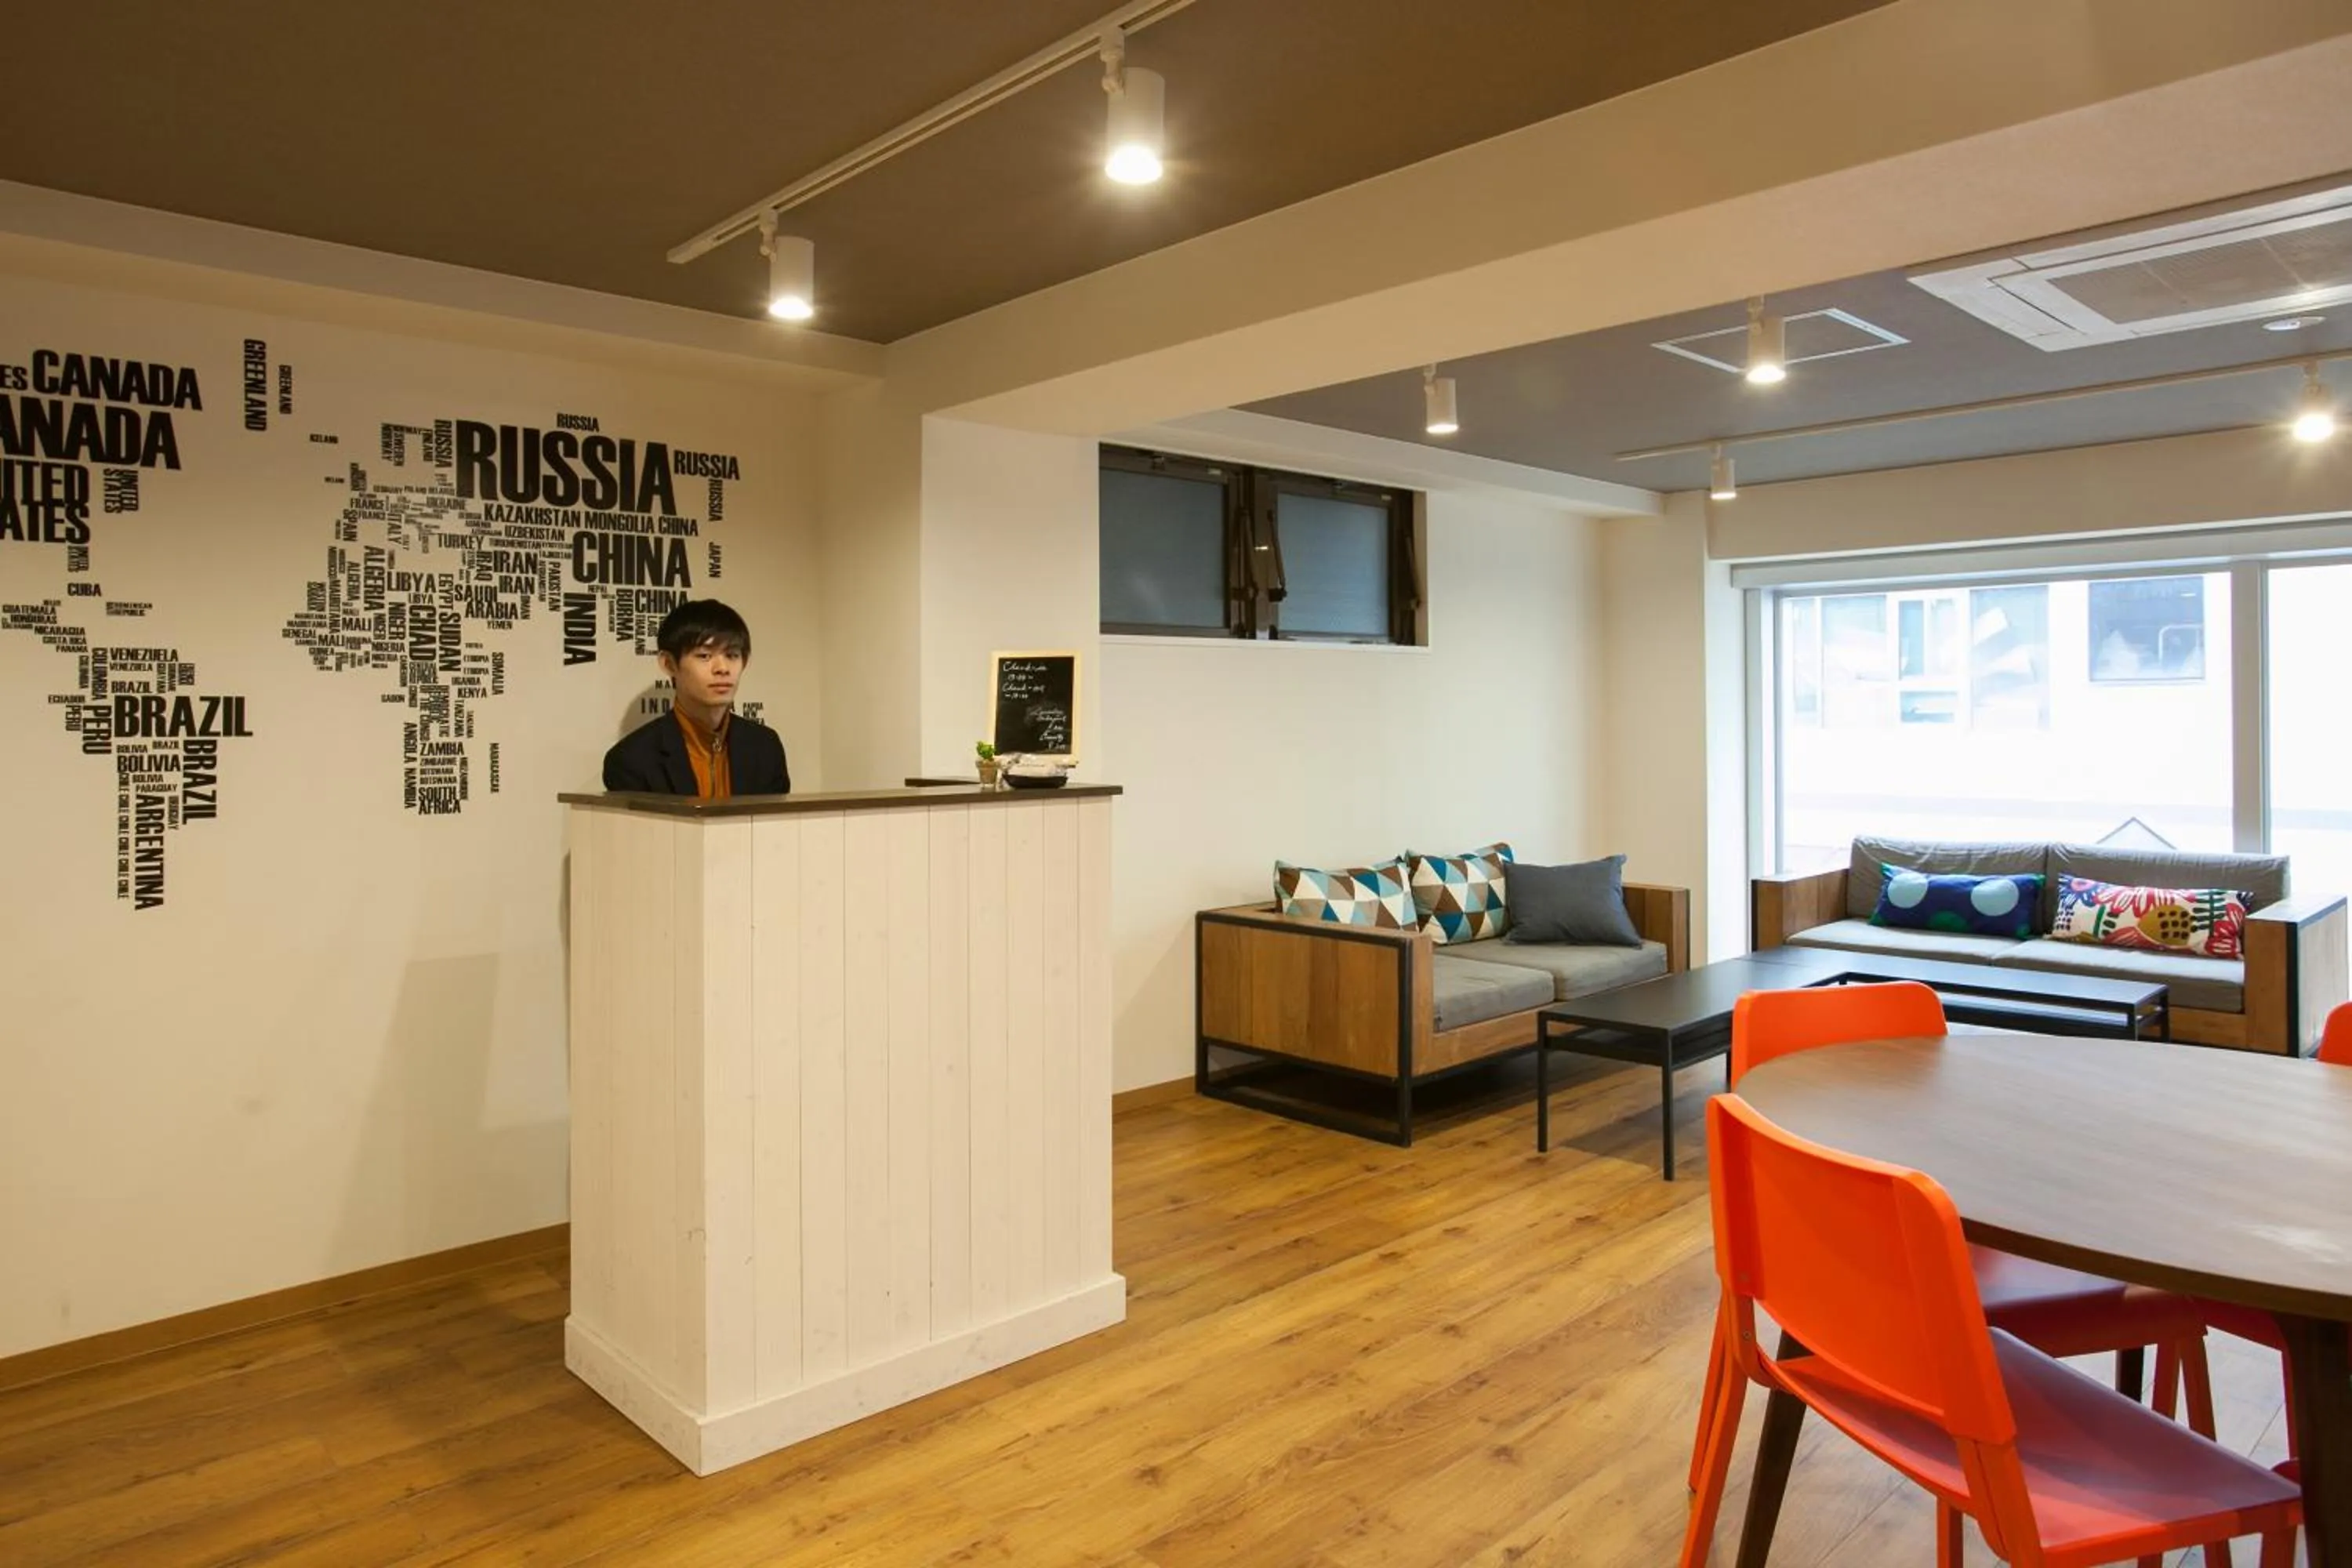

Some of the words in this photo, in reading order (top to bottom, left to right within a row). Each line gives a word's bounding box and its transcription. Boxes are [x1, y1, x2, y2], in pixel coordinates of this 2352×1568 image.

[33, 350, 202, 411] CANADA
[244, 339, 267, 431] GREENLAND
[279, 365, 292, 414] GREENLAND
[557, 413, 600, 432] RUSSIA
[435, 419, 452, 467] RUSSIA
[456, 419, 677, 516] RUSSIA
[673, 449, 740, 481] RUSSIA
[0, 459, 89, 507] ITED
[103, 469, 122, 514] STATES
[121, 470, 139, 511] UNITED
[350, 498, 384, 510] FRANCE
[709, 478, 724, 521] RUSSIA
[343, 509, 358, 542] SPAIN
[388, 513, 402, 545] ITALY
[484, 503, 581, 528] KAZAKHSTAN
[585, 510, 655, 535] MONGOLIA
[659, 514, 699, 536] CHINA
[504, 524, 565, 541] UZBEKISTAN
[437, 533, 485, 550] TURKEY
[474, 550, 492, 581] IRAQ
[493, 550, 537, 574] IRAN
[572, 530, 691, 588] CHINA
[709, 542, 721, 578] JAPAN
[67, 583, 101, 597] CUBA
[347, 561, 360, 601] ALGERIA
[364, 545, 385, 612] ALGERIA
[387, 571, 436, 593] LIBYA
[438, 573, 454, 610] EGYPT
[455, 584, 498, 602] SAUDI
[499, 575, 535, 594] IRAN
[549, 561, 561, 612] PAKISTAN
[408, 593, 433, 604] LIBYA
[465, 601, 518, 620] ARABIA
[521, 594, 531, 619] OMAN
[342, 618, 372, 631] MALI
[373, 612, 386, 640] NIGER
[388, 602, 406, 640] NIGER
[564, 593, 597, 666] INDIA
[616, 589, 633, 642] BURMA
[318, 635, 345, 647] MALI
[408, 604, 437, 661] CHAD
[439, 612, 461, 672] SUDAN
[110, 648, 178, 662] VENEZUELA
[110, 662, 153, 672] VENEZUELA
[111, 681, 153, 694] BRAZIL
[492, 652, 504, 695] SOMALIA
[458, 688, 487, 698] KENYA
[65, 705, 82, 731] PERU
[82, 705, 112, 754] PERU
[114, 695, 253, 738] BRAZIL
[404, 722, 417, 764] ANGOLA
[419, 742, 465, 756] ZAMBIA
[117, 754, 181, 773] BOLIVIA
[136, 784, 177, 793] PARAGUAY
[182, 739, 217, 825] BRAZIL
[419, 786, 457, 803] SOUTH
[418, 799, 461, 815] AFRICA
[135, 794, 165, 911] ARGENTINA
